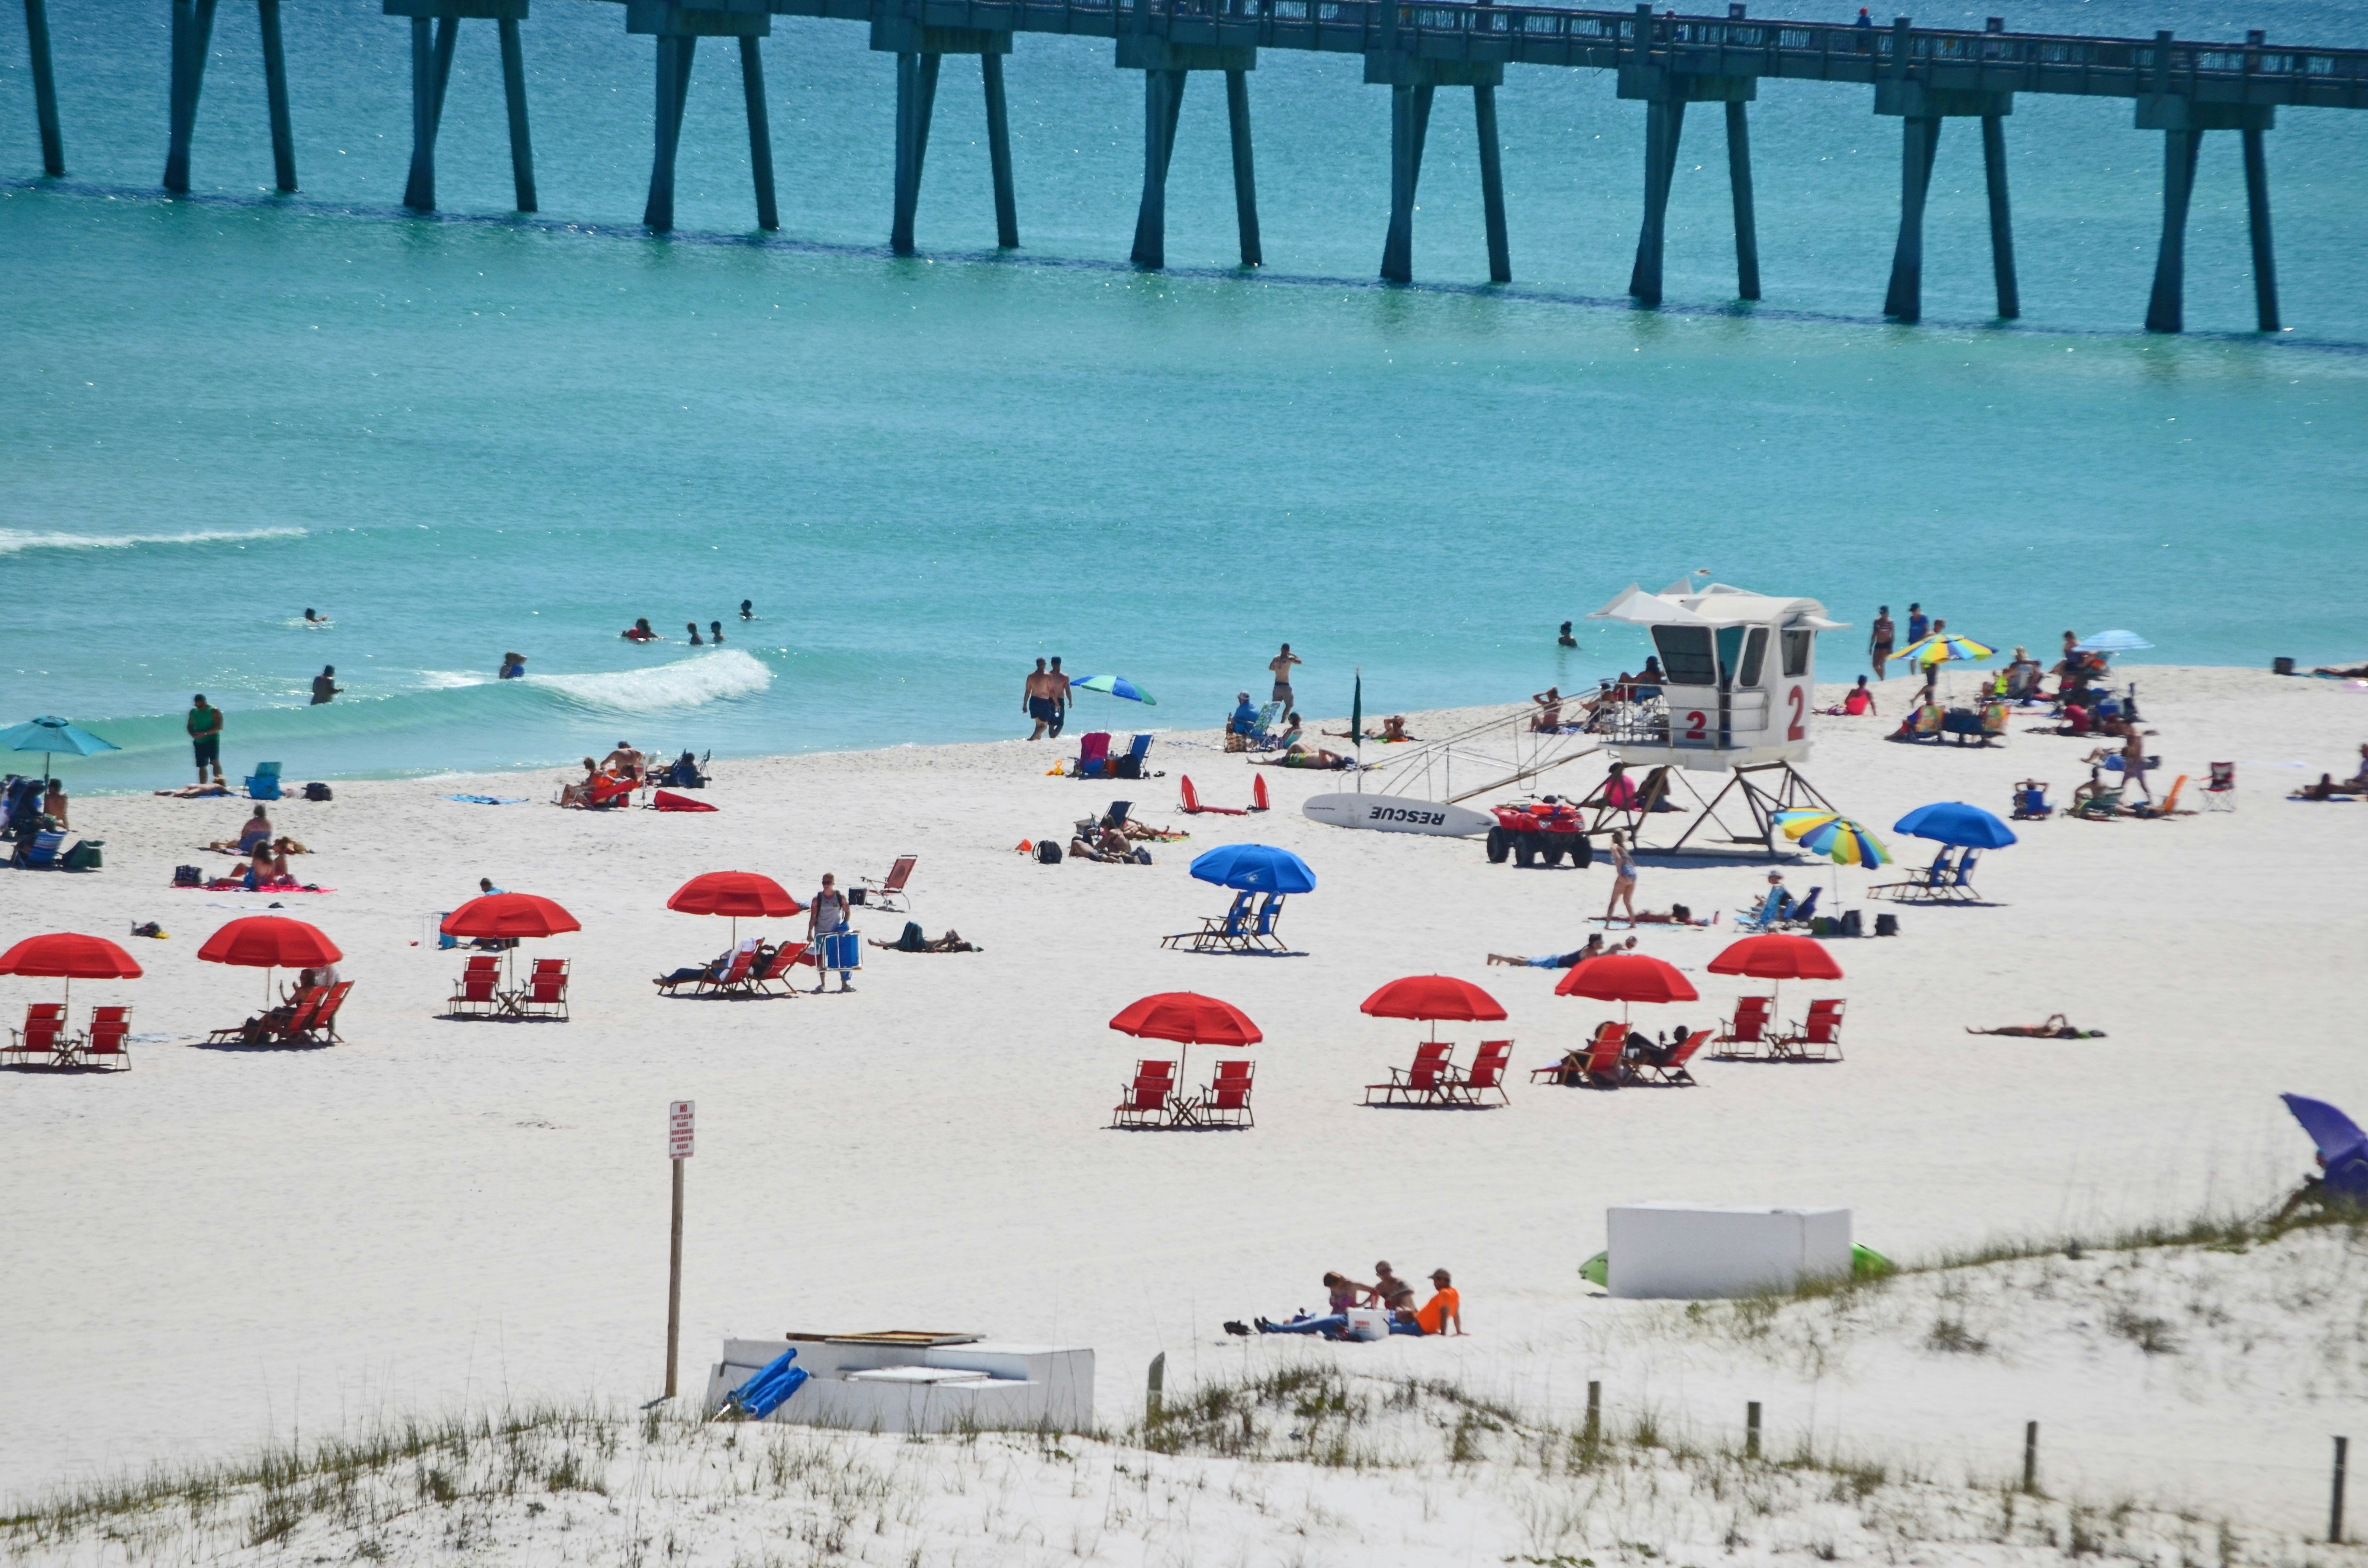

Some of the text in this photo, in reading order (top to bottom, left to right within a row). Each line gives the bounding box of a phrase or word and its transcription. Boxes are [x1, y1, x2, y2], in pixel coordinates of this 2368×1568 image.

[1686, 711, 1707, 739] 2
[1787, 685, 1805, 741] 2
[1369, 806, 1446, 826] RESCUE
[680, 1104, 687, 1113] NO
